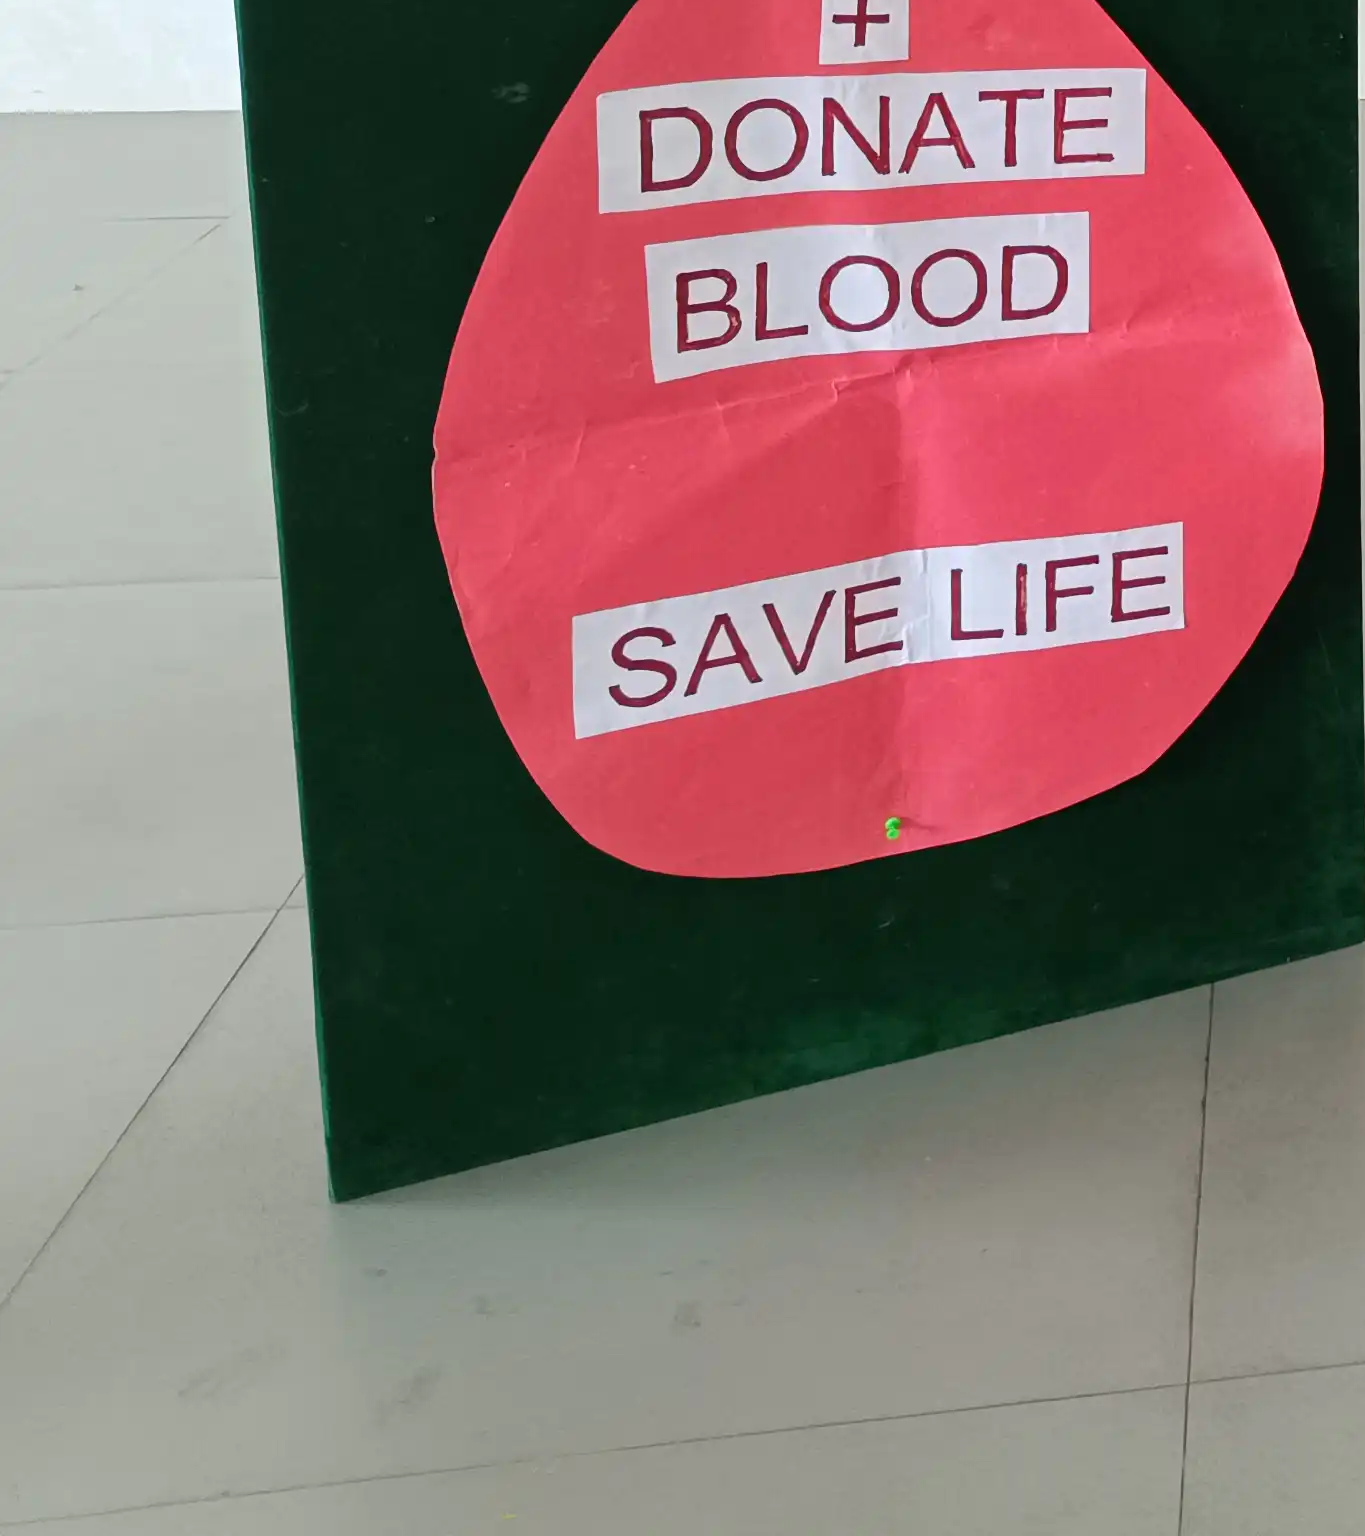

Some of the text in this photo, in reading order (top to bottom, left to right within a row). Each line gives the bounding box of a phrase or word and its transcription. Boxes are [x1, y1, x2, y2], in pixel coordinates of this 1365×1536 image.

[639, 86, 1114, 192] DONATE
[676, 245, 1068, 353] BLOOD
[609, 546, 1170, 707] SAVE LIFE
